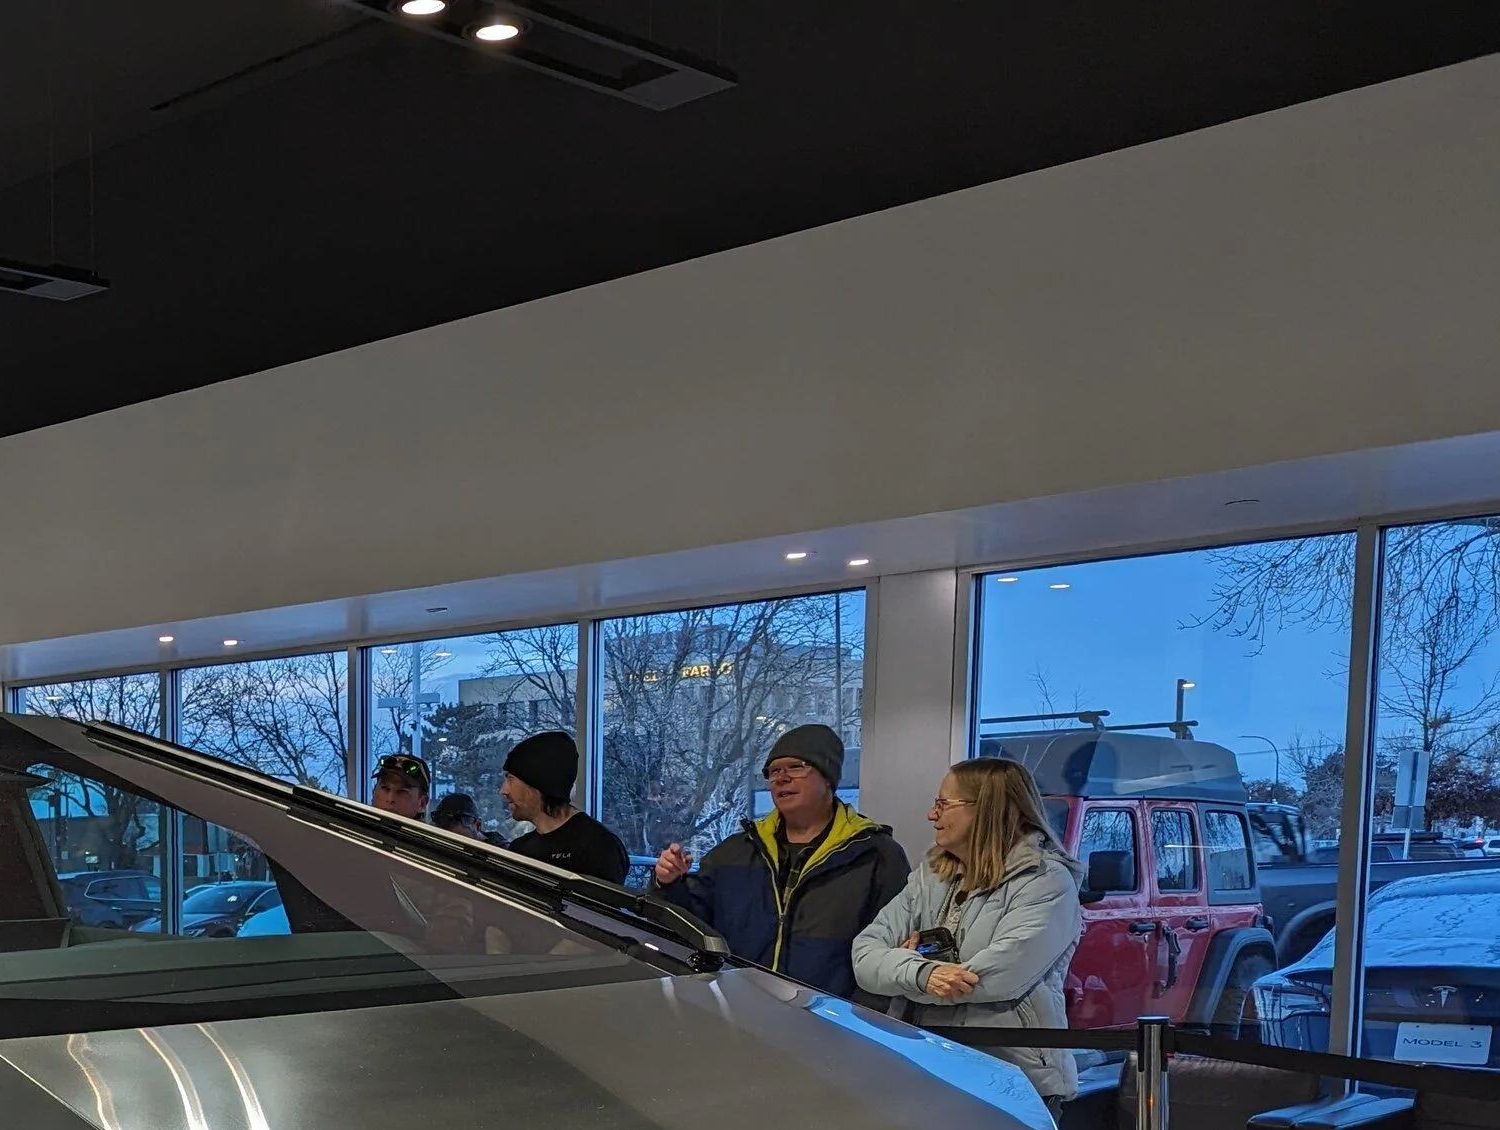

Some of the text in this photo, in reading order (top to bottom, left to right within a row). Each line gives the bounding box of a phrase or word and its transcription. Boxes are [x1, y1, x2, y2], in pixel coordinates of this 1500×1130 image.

[681, 661, 734, 678] FARO
[1403, 1037, 1482, 1049] MODEL 3
